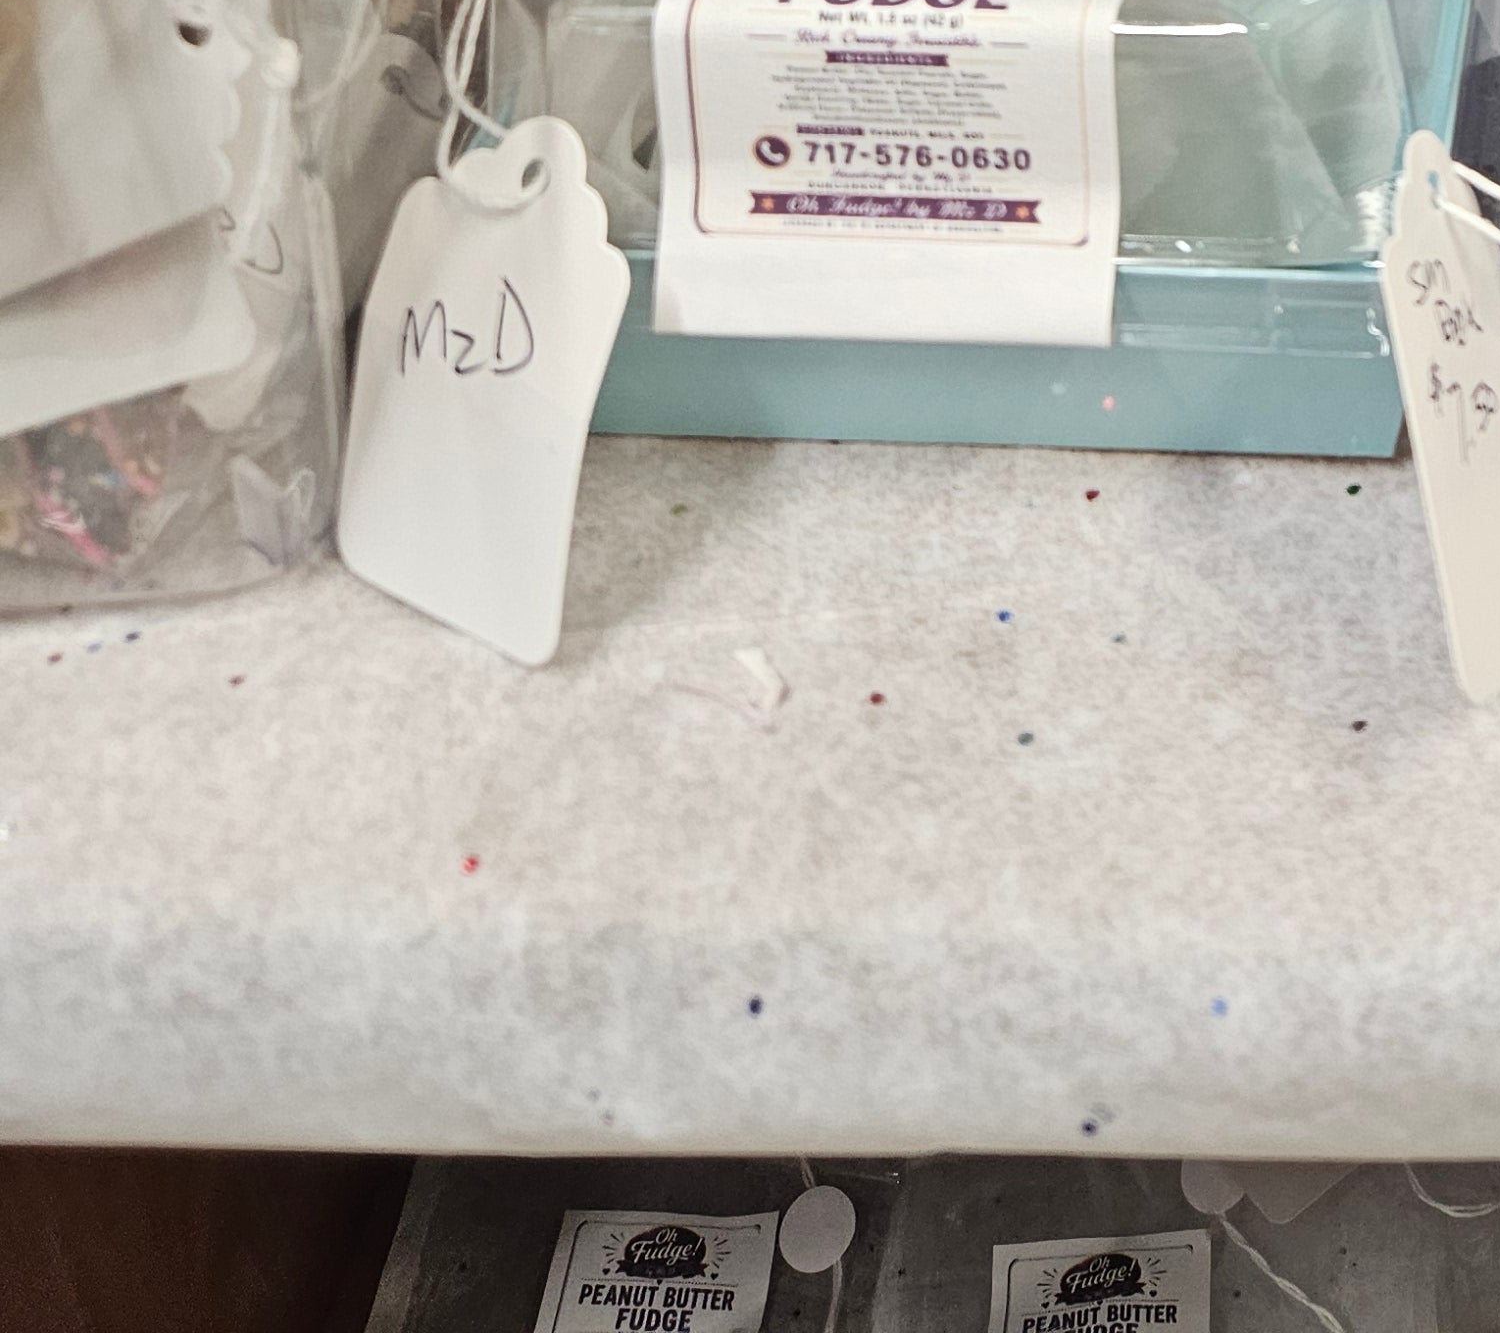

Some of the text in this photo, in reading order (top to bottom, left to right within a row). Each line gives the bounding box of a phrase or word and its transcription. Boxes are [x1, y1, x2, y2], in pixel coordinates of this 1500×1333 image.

[803, 140, 1032, 171] 717-576-0630
[903, 199, 932, 219] by
[655, 1229, 679, 1246] Oh
[631, 1237, 704, 1267] Fudge!
[1089, 1256, 1110, 1273] Oh
[1066, 1258, 1136, 1294] Fudge!
[578, 1284, 735, 1312] PEANUT BUTTER
[615, 1308, 694, 1333] FUDGE
[1022, 1307, 1101, 1333] PEANUT
[1107, 1304, 1177, 1324] BUTTER
